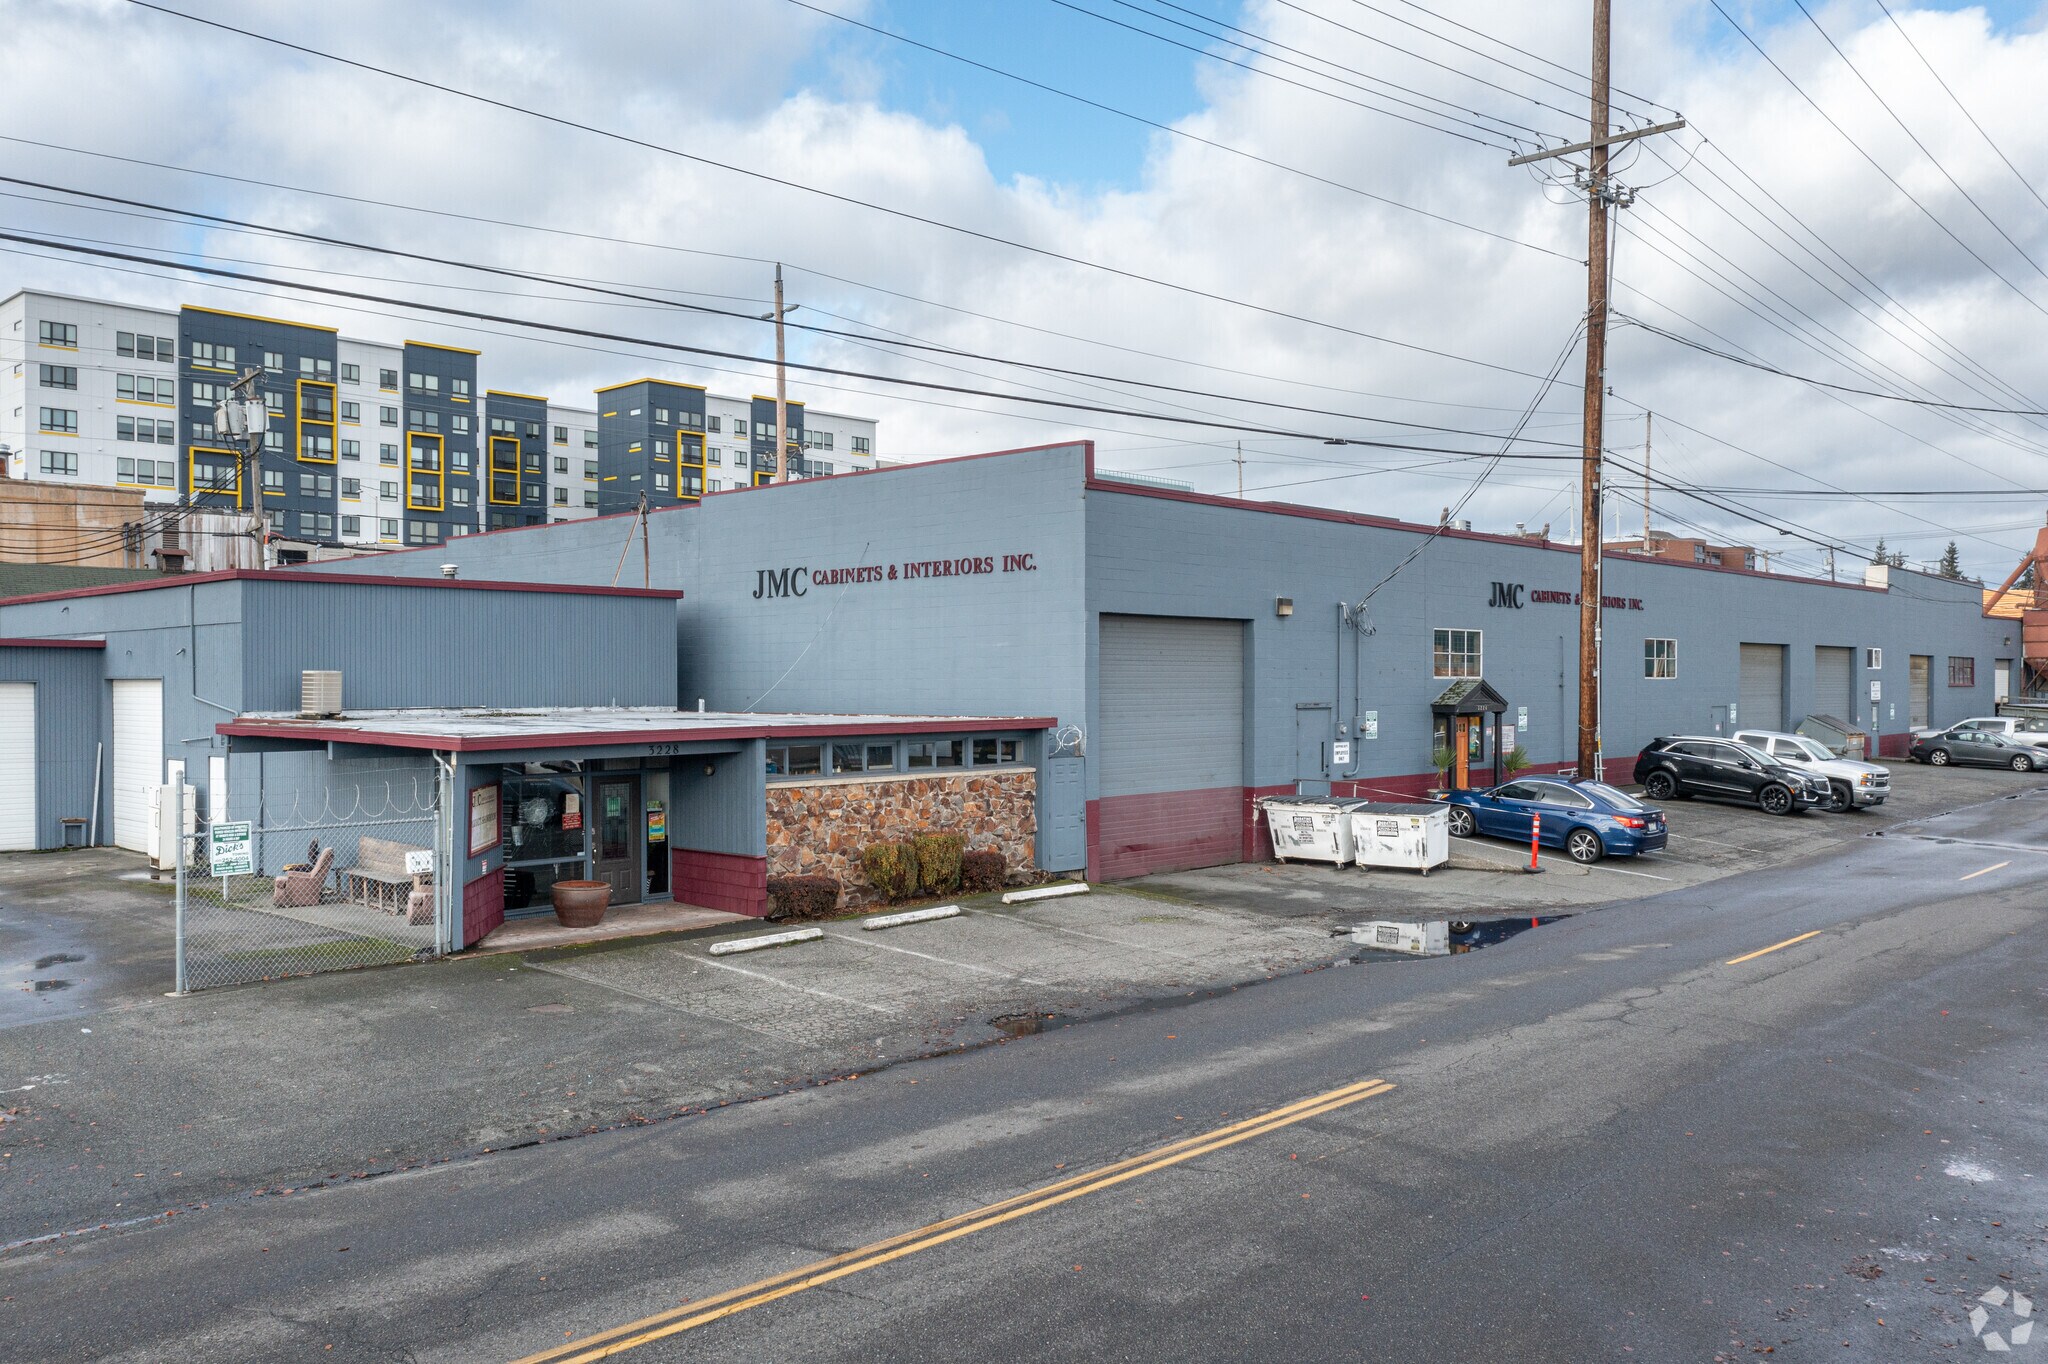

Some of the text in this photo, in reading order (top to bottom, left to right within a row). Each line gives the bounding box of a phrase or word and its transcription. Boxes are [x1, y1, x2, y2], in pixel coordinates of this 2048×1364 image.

[753, 553, 1037, 599] JMC CABINETS & INTERIORS INC.
[1489, 582, 1644, 610] JMC CABINETS & RIORS INC.
[648, 744, 679, 756] 3228
